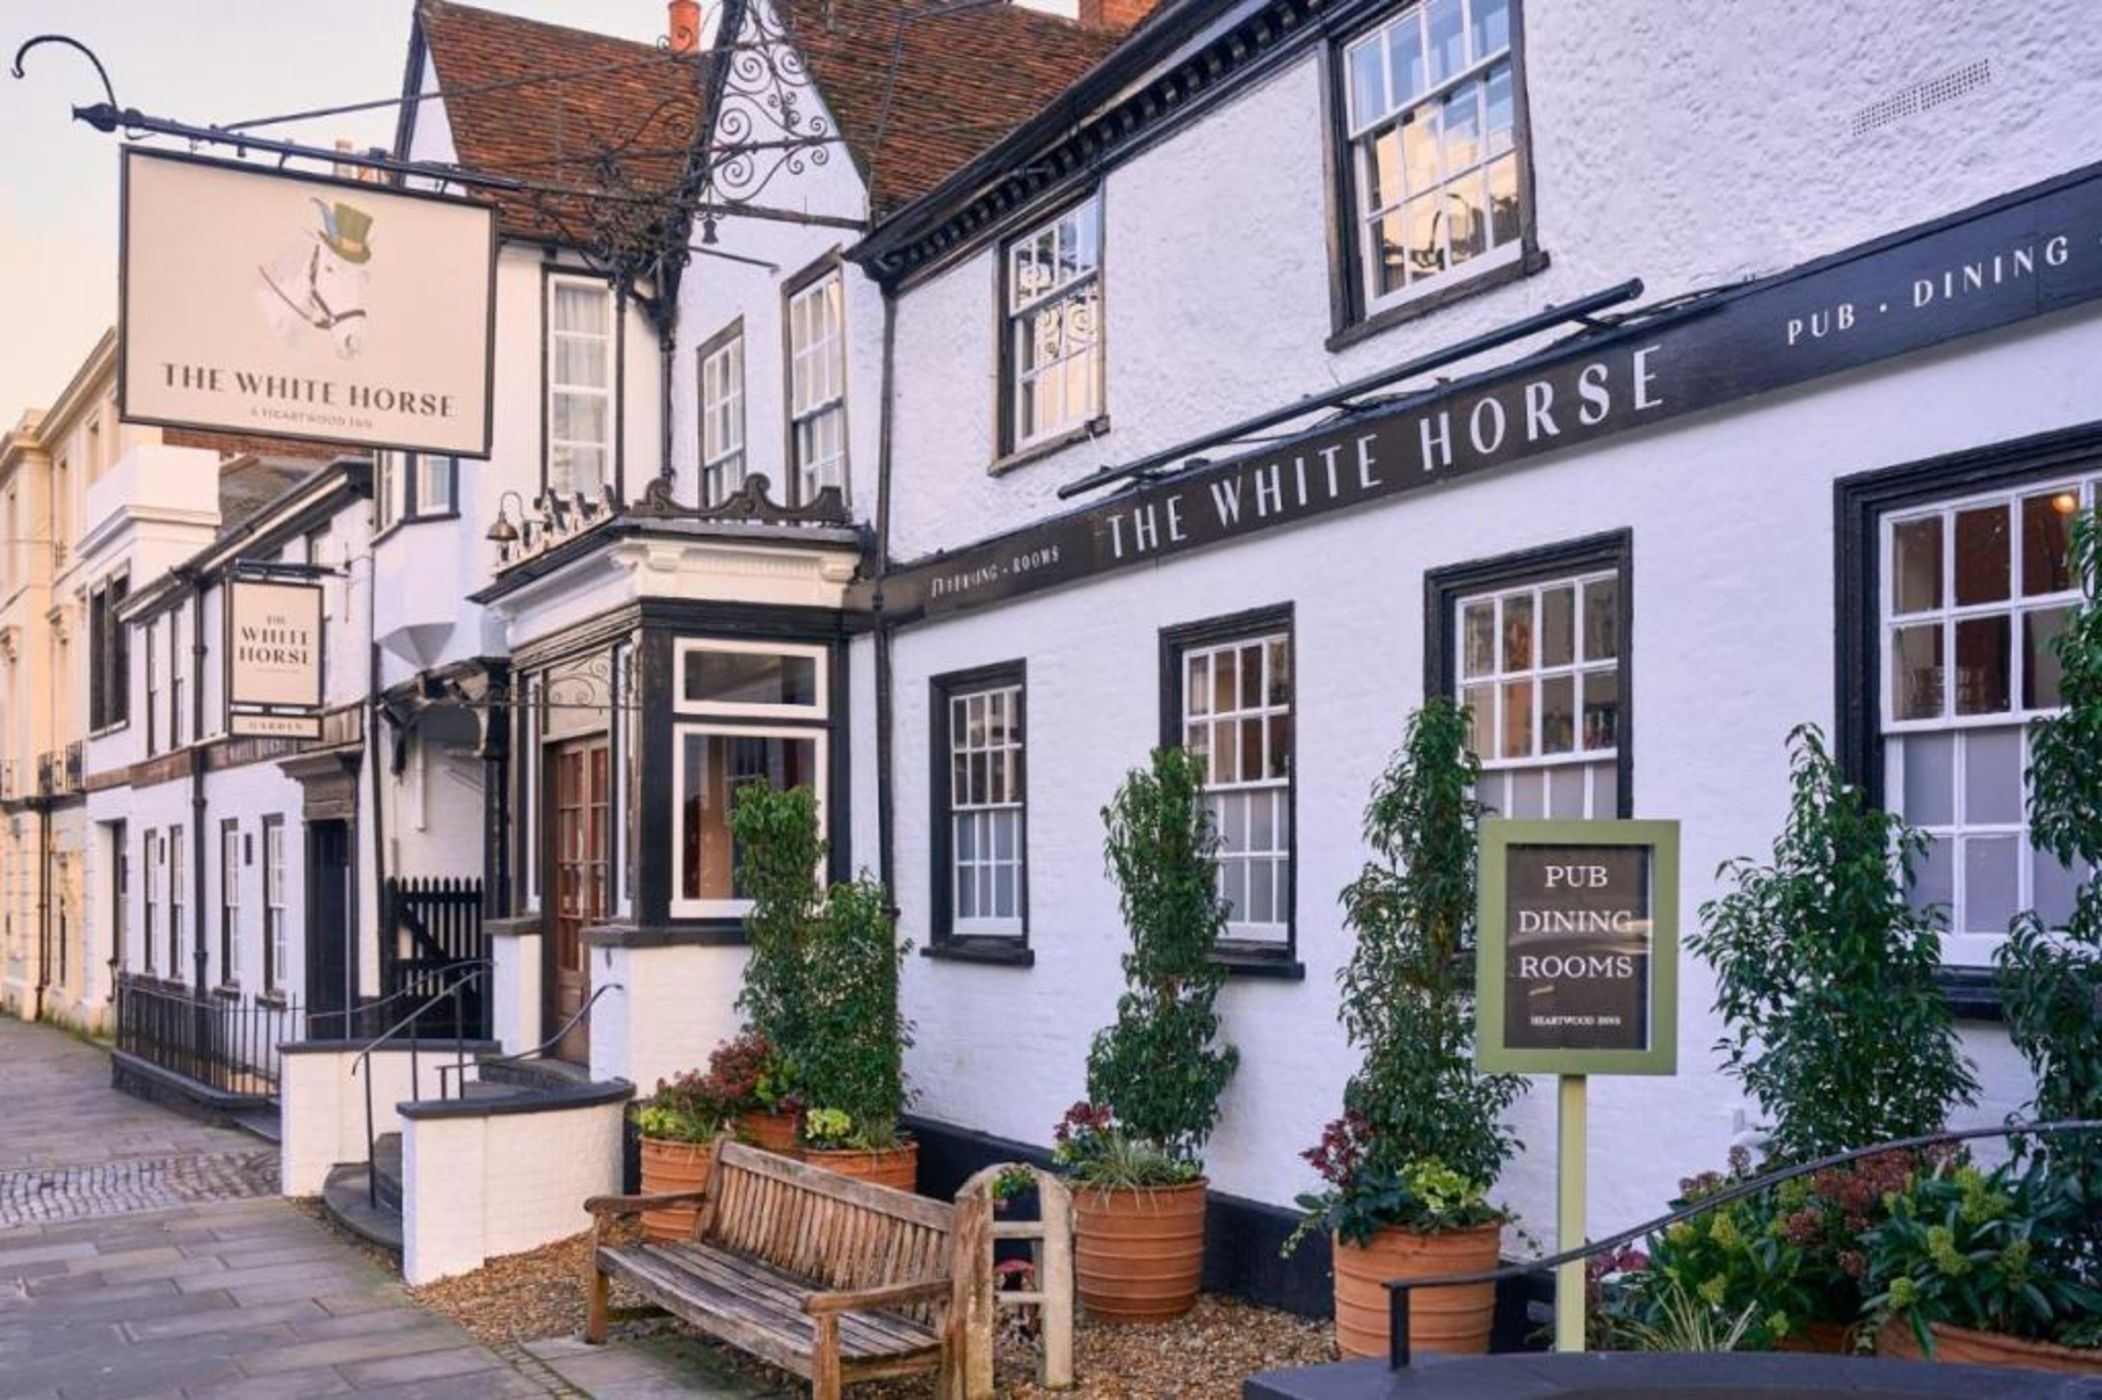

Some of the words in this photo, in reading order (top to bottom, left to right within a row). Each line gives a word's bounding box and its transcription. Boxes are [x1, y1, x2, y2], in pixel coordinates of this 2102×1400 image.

[1787, 304, 1855, 345] PUB
[1913, 235, 2068, 307] DINING
[162, 361, 226, 393] THE
[234, 371, 338, 406] WHITE
[349, 384, 458, 420] HORSE
[1107, 493, 1187, 559] THE
[1210, 432, 1383, 528] WHITE
[1418, 344, 1664, 472] HORSE
[1013, 545, 1059, 573] ROOMS
[1545, 866, 1608, 887] PUB
[1518, 910, 1632, 933] DINING
[1520, 956, 1633, 979] ROOMS
